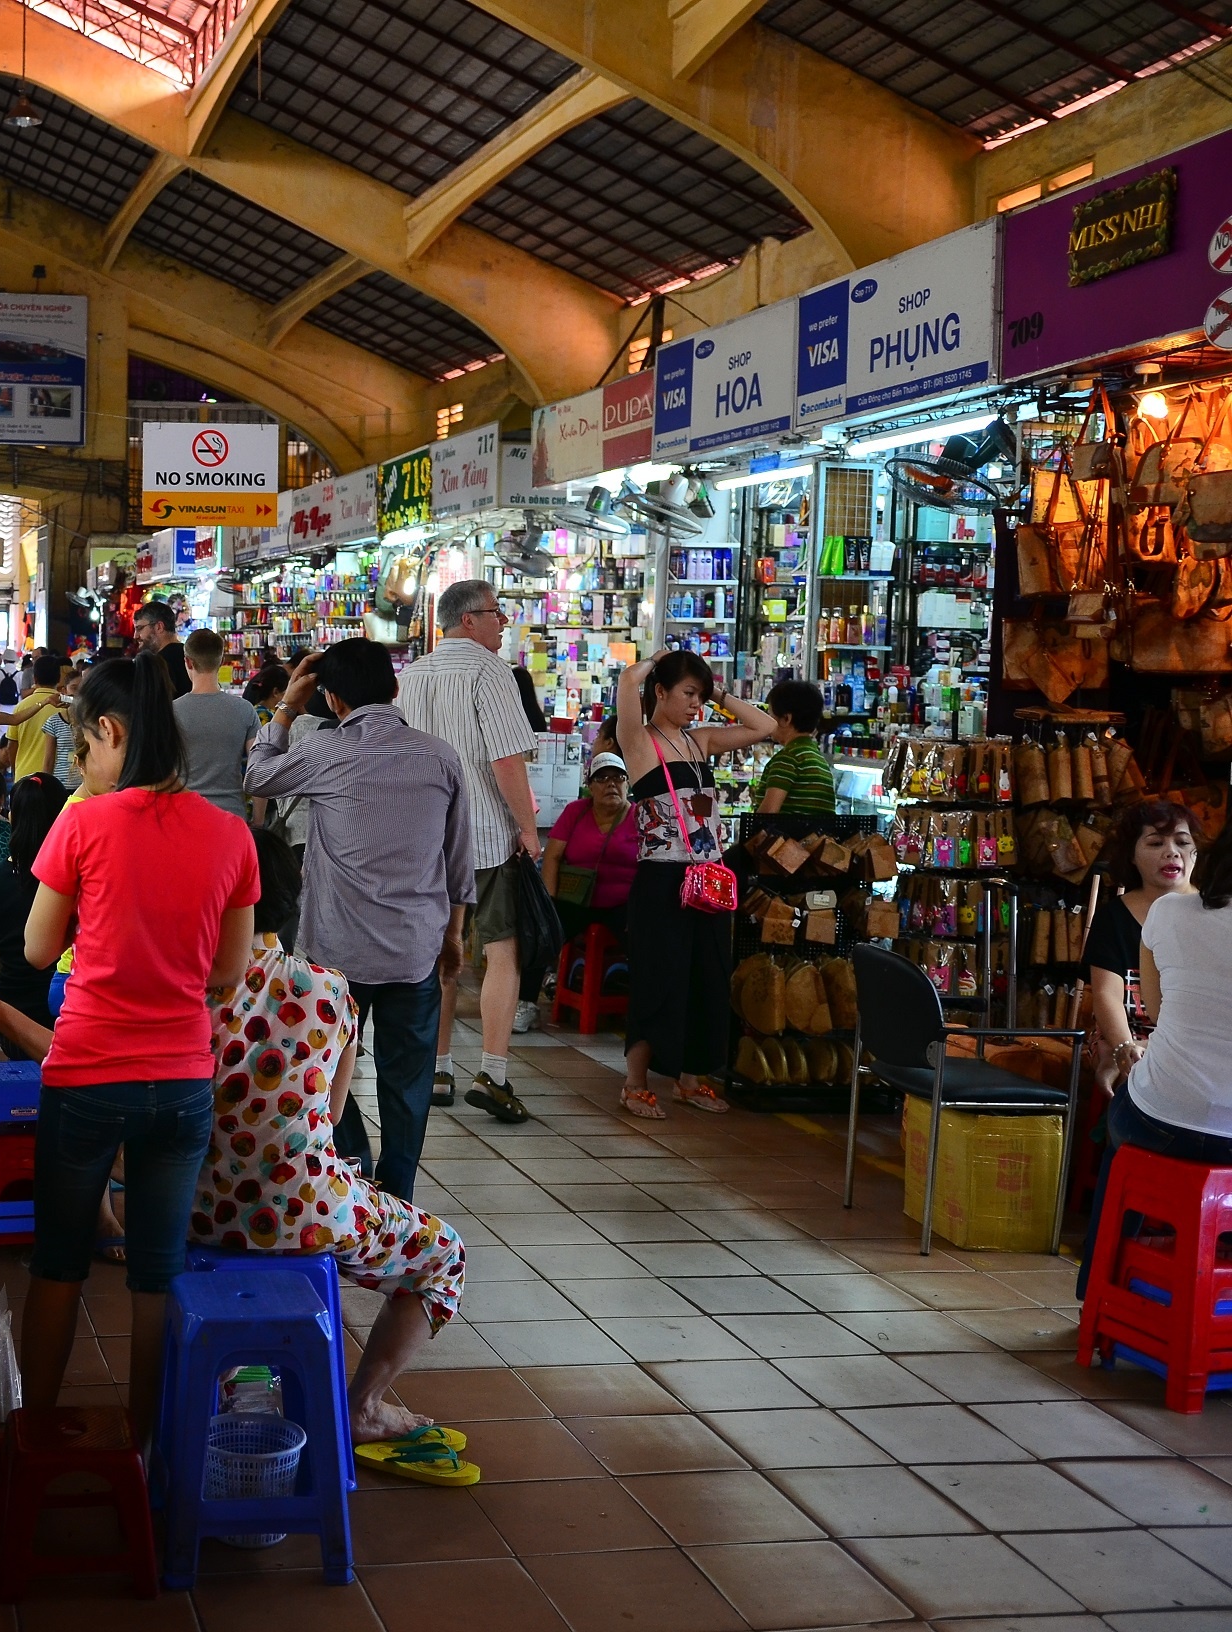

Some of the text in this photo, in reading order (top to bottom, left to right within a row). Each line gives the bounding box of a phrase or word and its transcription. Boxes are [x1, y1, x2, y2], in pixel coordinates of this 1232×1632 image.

[1068, 201, 1164, 252] MISS NHI
[1214, 231, 1229, 250] NO
[865, 285, 874, 295] 711
[898, 288, 931, 314] SHOP
[808, 314, 838, 332] we prefer
[1008, 312, 1044, 348] 709
[807, 338, 839, 367] VISA
[870, 312, 960, 373] PHỤNG
[728, 351, 751, 370] SHOP
[671, 368, 686, 379] prefer
[892, 388, 902, 397] Bến
[903, 384, 919, 395] Thành
[944, 373, 958, 384] 3520
[959, 369, 972, 380] 1745
[662, 387, 686, 410] VISA
[716, 373, 762, 418] HOA
[801, 394, 843, 416] Sacombank
[605, 394, 653, 429] PUPA
[478, 433, 494, 455] 717
[506, 447, 527, 459] Mỹ
[656, 435, 687, 452] Sacombank
[156, 472, 266, 486] NO SMOKING
[401, 457, 432, 500] 719
[439, 468, 458, 494] Kim
[510, 493, 526, 504] CỬA
[529, 495, 550, 505] ĐÔNG
[552, 495, 566, 506] CHỢ
[183, 547, 196, 556] VIS
